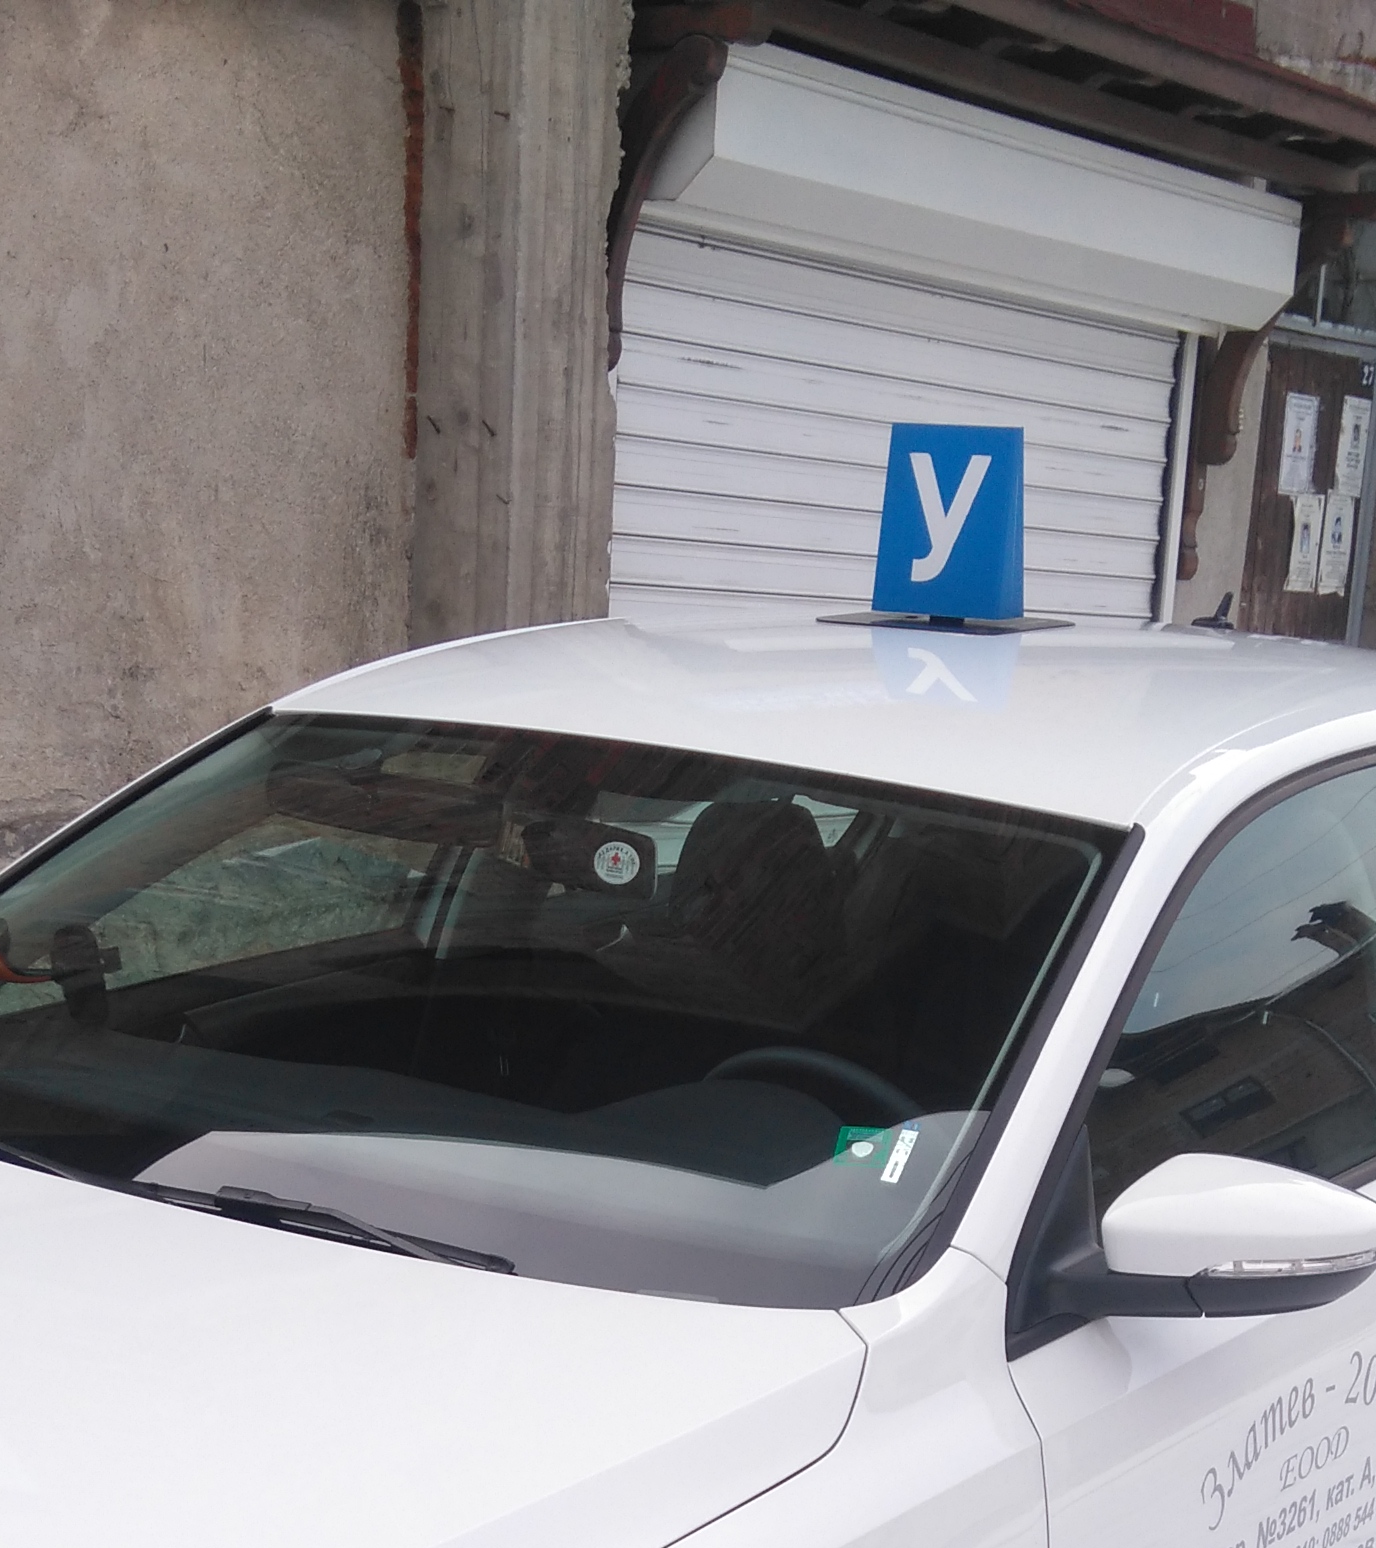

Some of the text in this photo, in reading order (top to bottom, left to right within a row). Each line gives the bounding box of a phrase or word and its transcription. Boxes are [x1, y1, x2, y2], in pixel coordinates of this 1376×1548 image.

[1200, 1377, 1315, 1531] Златев
[1325, 1473, 1355, 1512] кат.
[1353, 1497, 1375, 1532] 544
